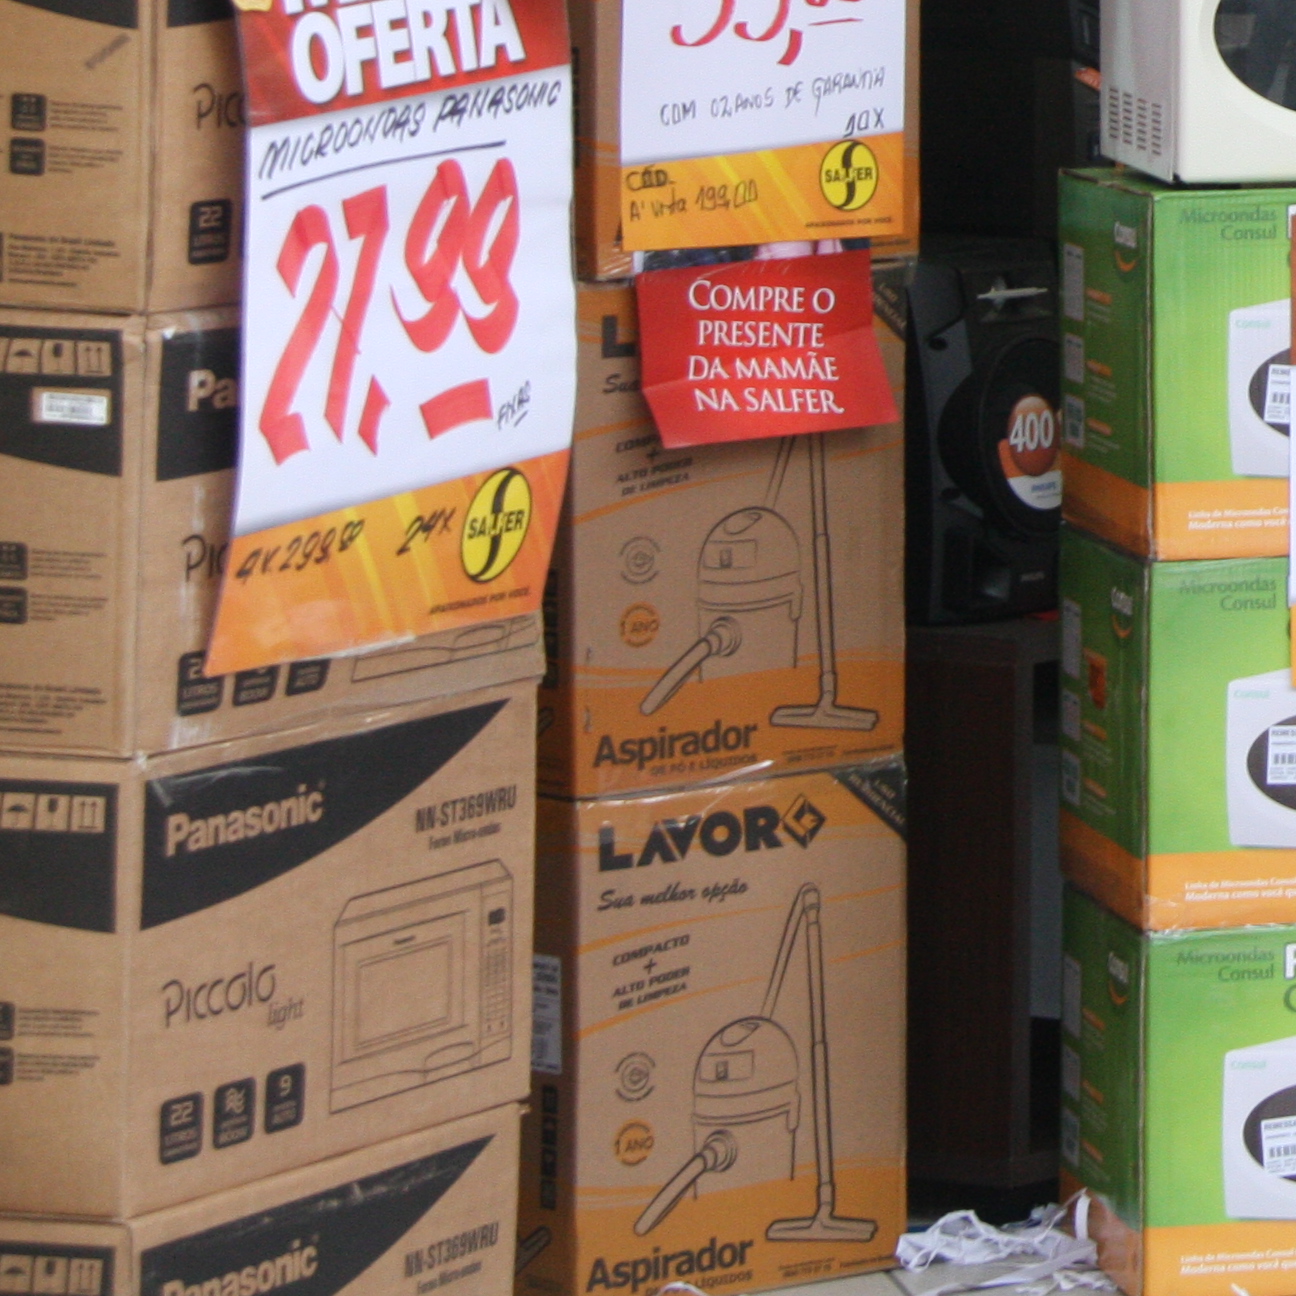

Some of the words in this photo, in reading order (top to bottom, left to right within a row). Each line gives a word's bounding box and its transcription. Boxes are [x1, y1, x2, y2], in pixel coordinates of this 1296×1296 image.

[660, 100, 696, 125] COM
[784, 81, 803, 108] DE
[257, 100, 424, 180] MICROONDAS
[434, 80, 561, 131] PANASONIC
[1181, 206, 1277, 224] Microondas
[1220, 224, 1277, 241] Consul
[688, 279, 804, 312] COMPRE
[812, 287, 835, 314] O
[699, 319, 825, 349] PRESENTE
[688, 355, 729, 381] DA
[736, 352, 839, 381] MAMÃE
[694, 387, 739, 412] NA
[744, 387, 845, 414] SALFER.
[1009, 409, 1054, 453] 400
[1180, 578, 1277, 594] Microondas
[1220, 593, 1277, 611] Consul
[593, 720, 758, 771] Aspirador
[165, 784, 323, 858] Panasonic
[415, 785, 518, 834] NN-ST369WRU
[599, 805, 783, 872] LAVOR
[597, 888, 634, 911] Sua
[641, 882, 696, 906] melhor
[702, 878, 748, 903] opção
[613, 934, 690, 967] COMPACTO
[1177, 949, 1275, 965] Microondas
[613, 980, 645, 998] ALTO
[649, 966, 690, 987] PODER
[1218, 965, 1275, 981] Consul
[163, 962, 276, 1030] Piccolo
[170, 1104, 193, 1126] 22
[624, 1134, 654, 1154] ANO
[163, 1239, 319, 1296] Panasonic
[585, 1238, 754, 1292] Aspirador
